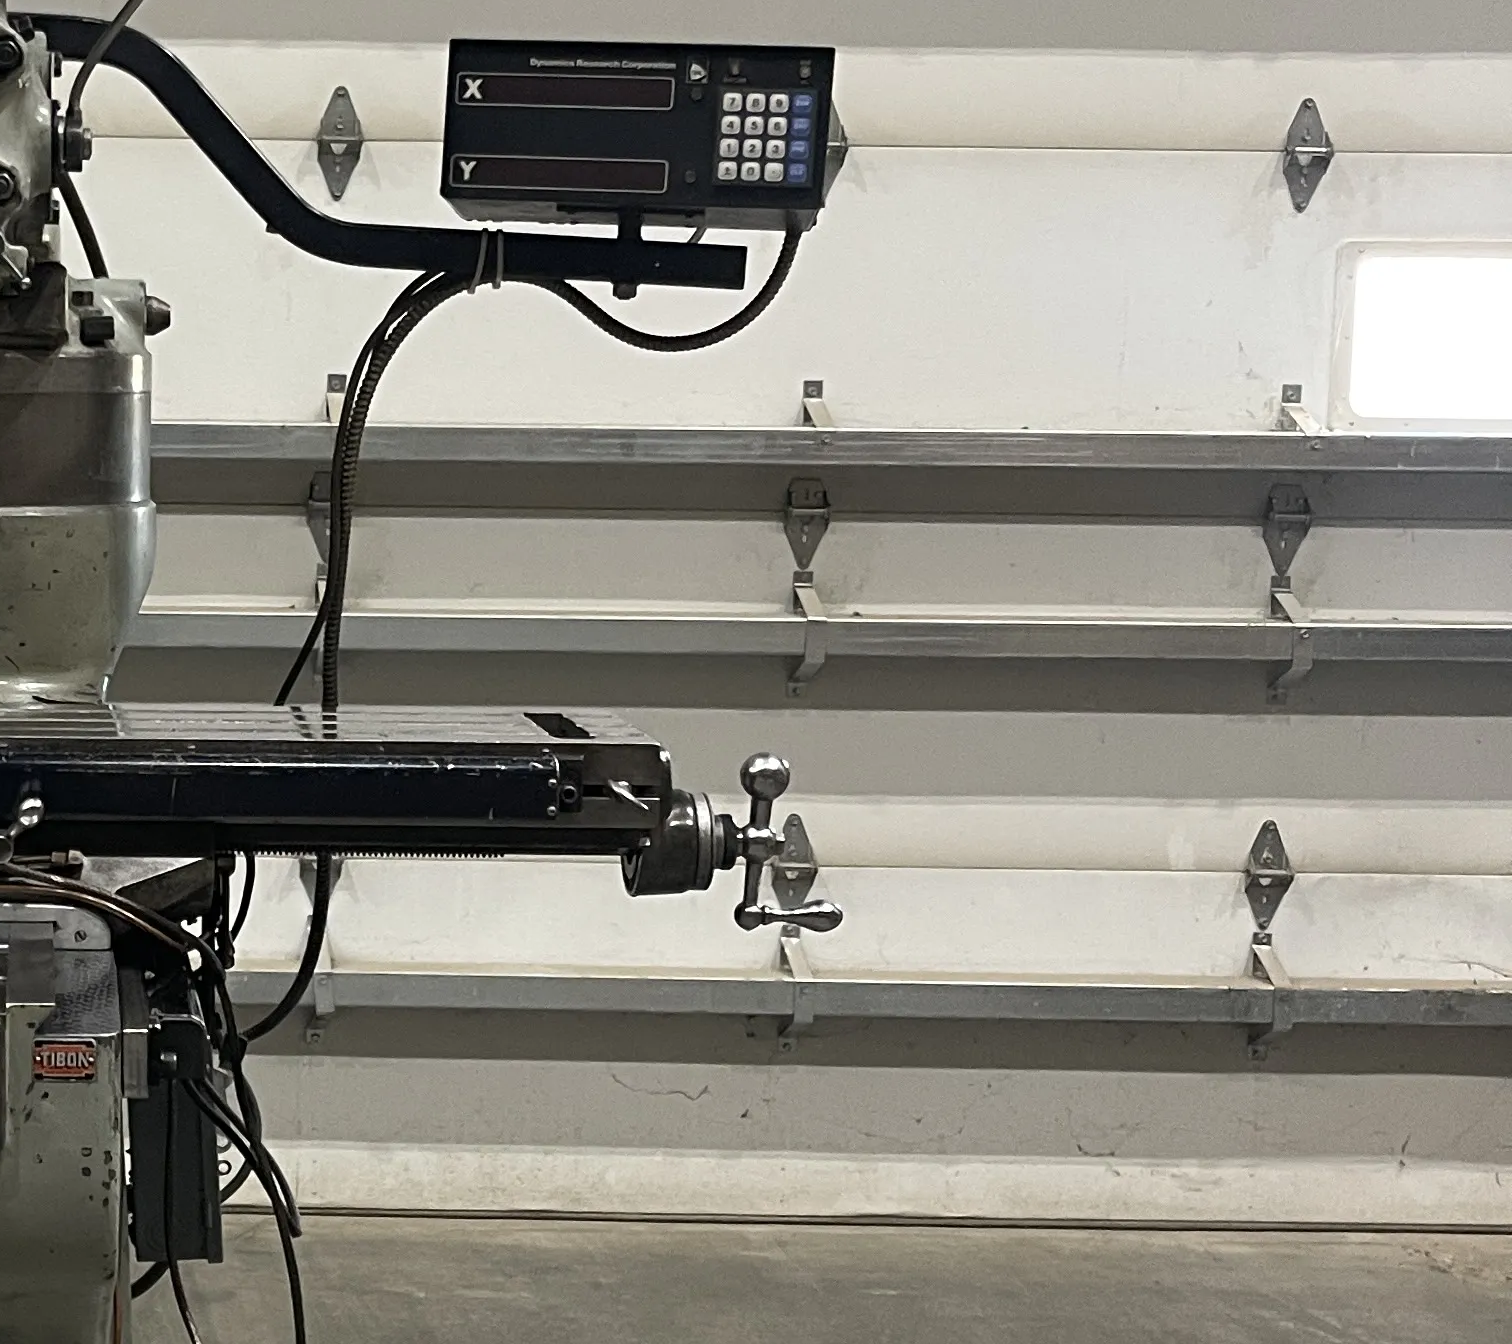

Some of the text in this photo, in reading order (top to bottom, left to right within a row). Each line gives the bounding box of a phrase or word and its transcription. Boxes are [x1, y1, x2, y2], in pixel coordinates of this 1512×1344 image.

[463, 78, 484, 100] X
[459, 160, 478, 182] Y
[40, 1051, 90, 1068] TIBON
